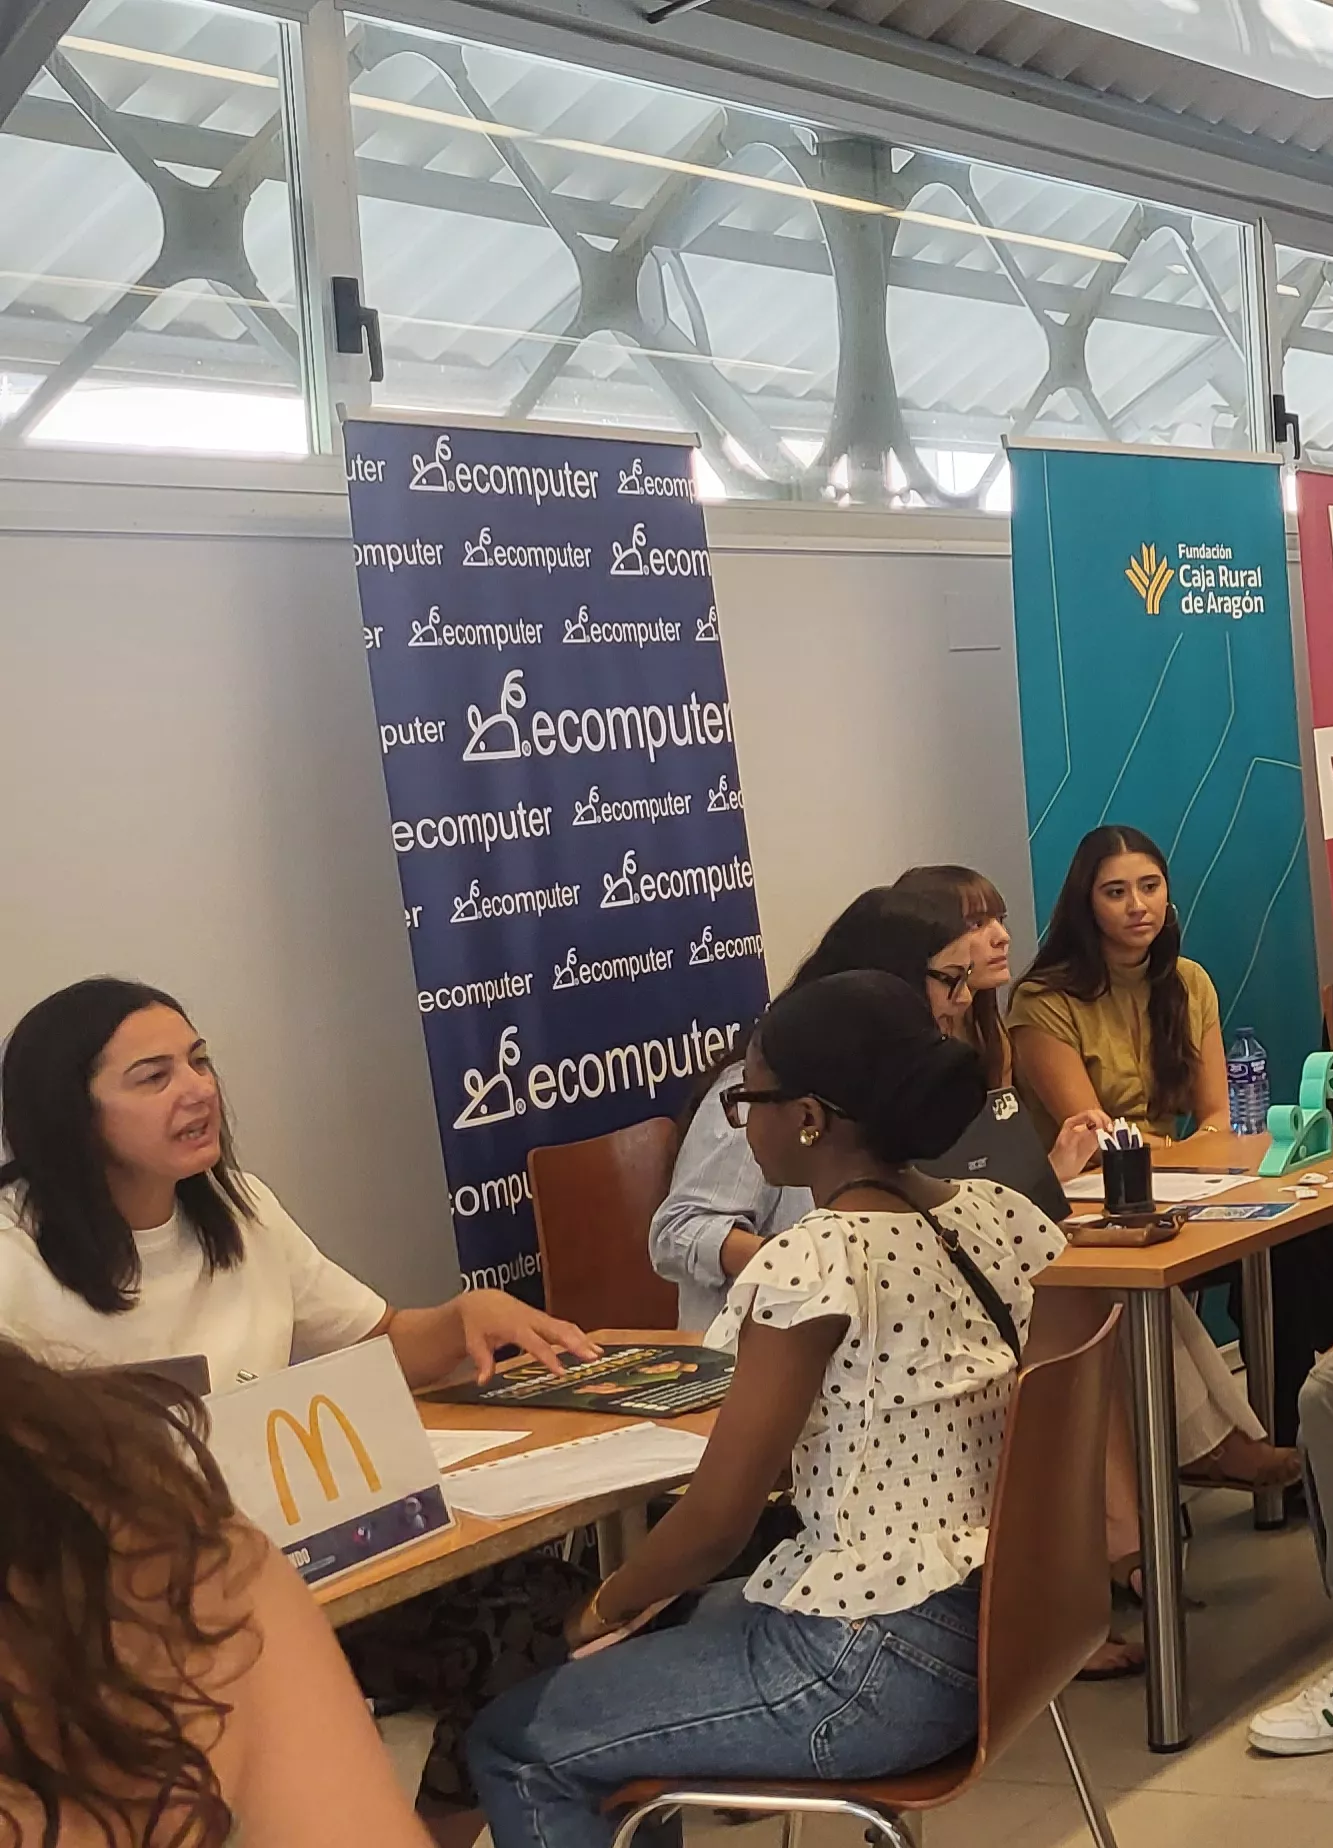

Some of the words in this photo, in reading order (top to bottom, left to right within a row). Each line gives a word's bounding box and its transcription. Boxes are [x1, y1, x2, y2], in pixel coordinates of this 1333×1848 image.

[455, 461, 599, 505] ecomputer
[493, 542, 591, 574] ecomputer
[649, 548, 712, 576] ecom
[1178, 543, 1233, 560] Fundación
[1179, 564, 1215, 592] Caja
[1218, 564, 1262, 588] Rural
[1181, 590, 1204, 614] de
[1206, 590, 1265, 619] Aragón
[443, 618, 543, 651] ecomputer
[590, 617, 681, 649] ecomputer
[531, 691, 733, 763] ecomputer
[600, 790, 692, 824] ecomputer
[391, 802, 552, 852] ecomputer
[639, 856, 754, 902] ecompute
[481, 882, 581, 920] ecomputer
[579, 946, 674, 985] ecomputer
[418, 971, 534, 1013] ecomputer
[527, 1017, 741, 1110] ecomputer
